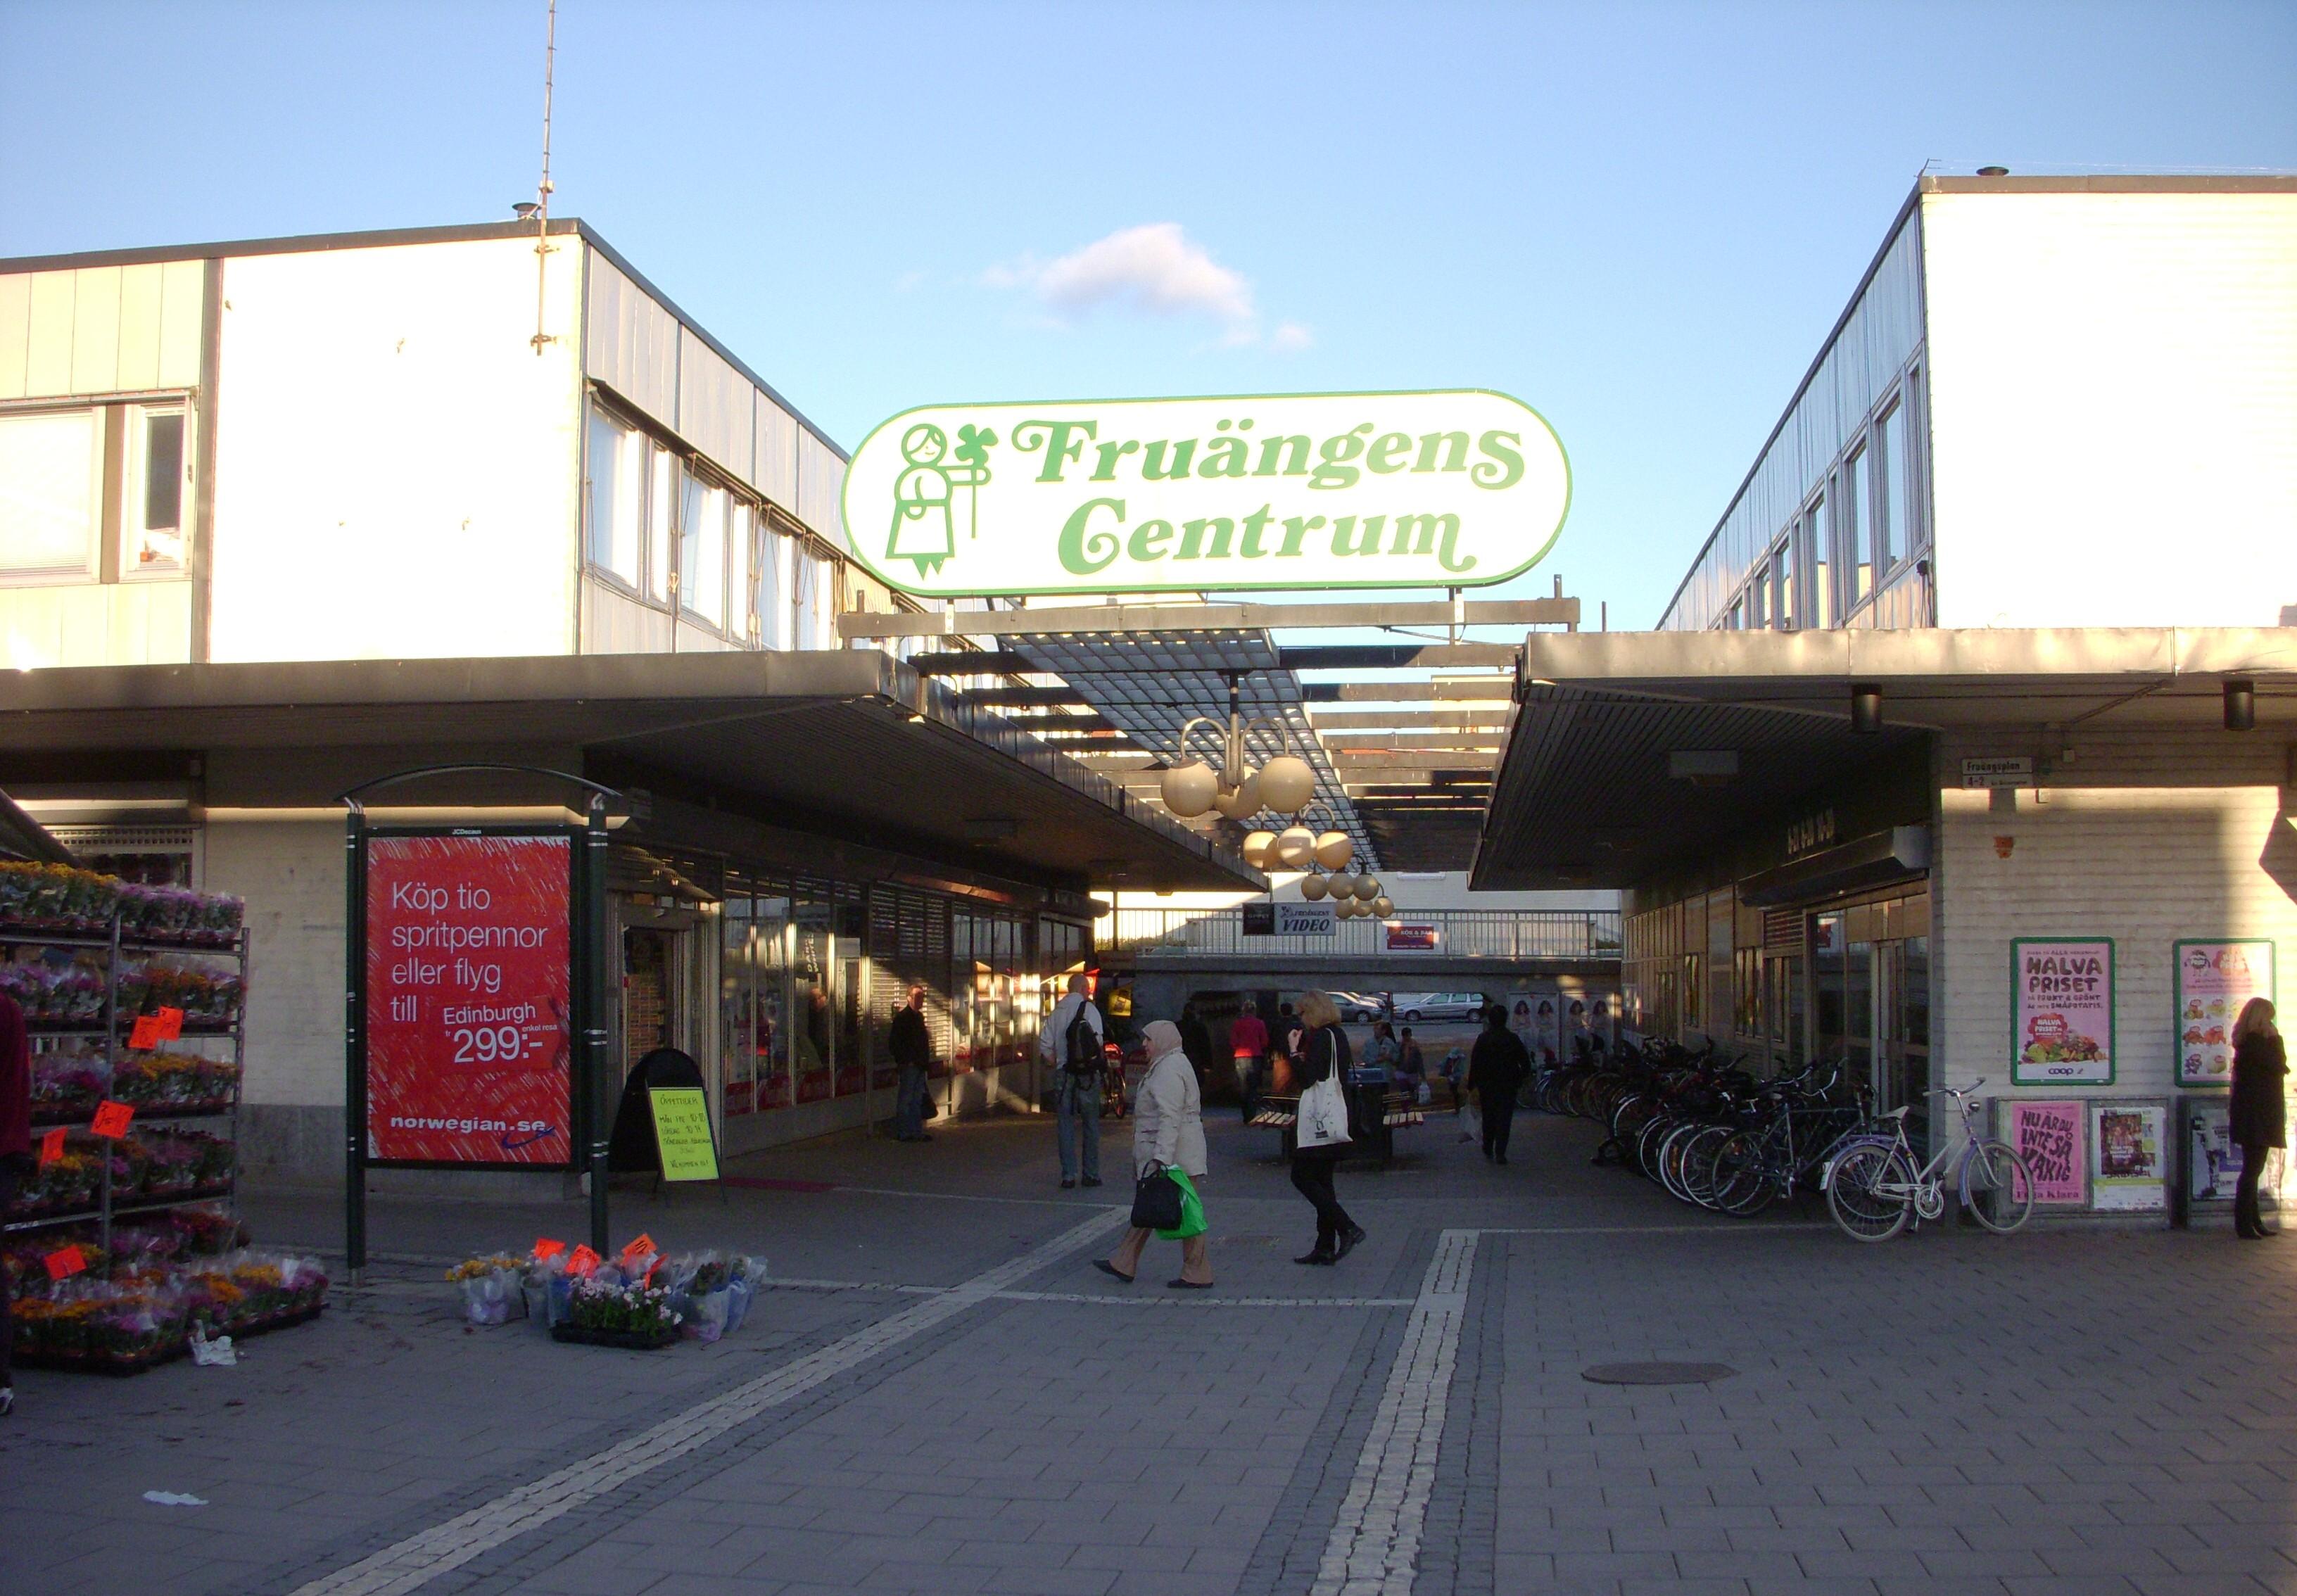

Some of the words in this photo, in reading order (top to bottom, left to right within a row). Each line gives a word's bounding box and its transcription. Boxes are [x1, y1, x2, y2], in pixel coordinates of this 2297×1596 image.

[1011, 418, 1526, 490] Fruängens
[1057, 498, 1477, 575] Centrum
[393, 881, 449, 916] Köp
[457, 882, 491, 910] tio
[392, 920, 549, 954] spritpennor
[1283, 918, 1330, 932] VIDEO
[392, 958, 447, 985] eller
[454, 958, 501, 993] flyg
[2027, 956, 2103, 975] HALVA
[2029, 976, 2099, 993] PRISET
[390, 995, 417, 1022] till
[443, 1002, 536, 1025] Edinburgh
[454, 1025, 543, 1064] 299:-
[2048, 1068, 2074, 1076] coop
[391, 1116, 546, 1134] norwegian.se
[2020, 1110, 2041, 1127] NU
[2041, 1111, 2059, 1130] ÄR
[2059, 1118, 2074, 1132] DU
[2020, 1128, 2054, 1151] INTE
[2049, 1132, 2074, 1161] SÅ
[2047, 1190, 2079, 1198] Klara
